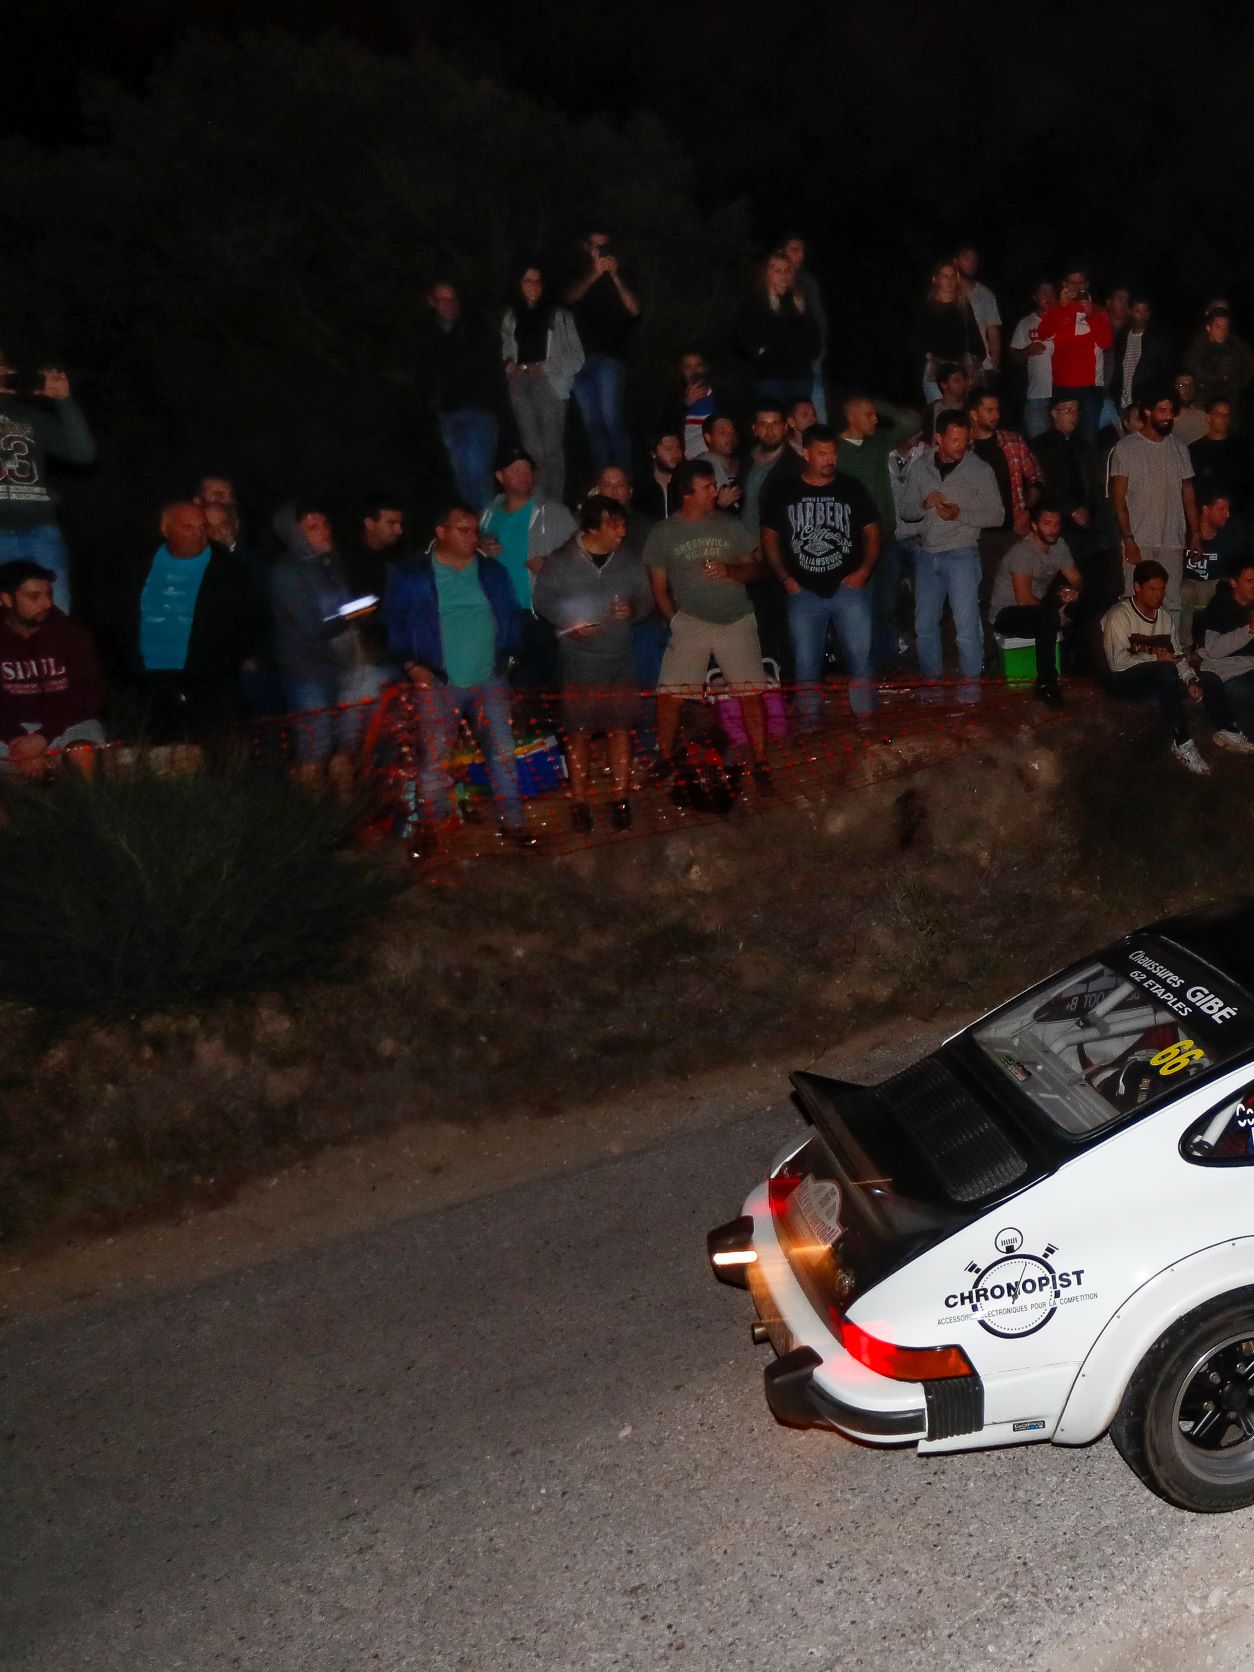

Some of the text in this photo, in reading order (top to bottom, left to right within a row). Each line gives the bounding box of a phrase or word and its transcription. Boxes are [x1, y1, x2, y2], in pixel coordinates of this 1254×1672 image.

[1128, 950, 1185, 988] Chaussures
[1186, 985, 1239, 1024] GIBÉ
[1129, 970, 1147, 982] 62
[1142, 979, 1193, 1017] ETAPLES
[1149, 1039, 1205, 1076] 66
[944, 1269, 1085, 1309] CHRONOPIST
[981, 1305, 1028, 1320] LECTRONIQUES
[1030, 1301, 1047, 1311] POUR
[1049, 1298, 1057, 1307] LA
[1059, 1291, 1099, 1306] COMPETITION
